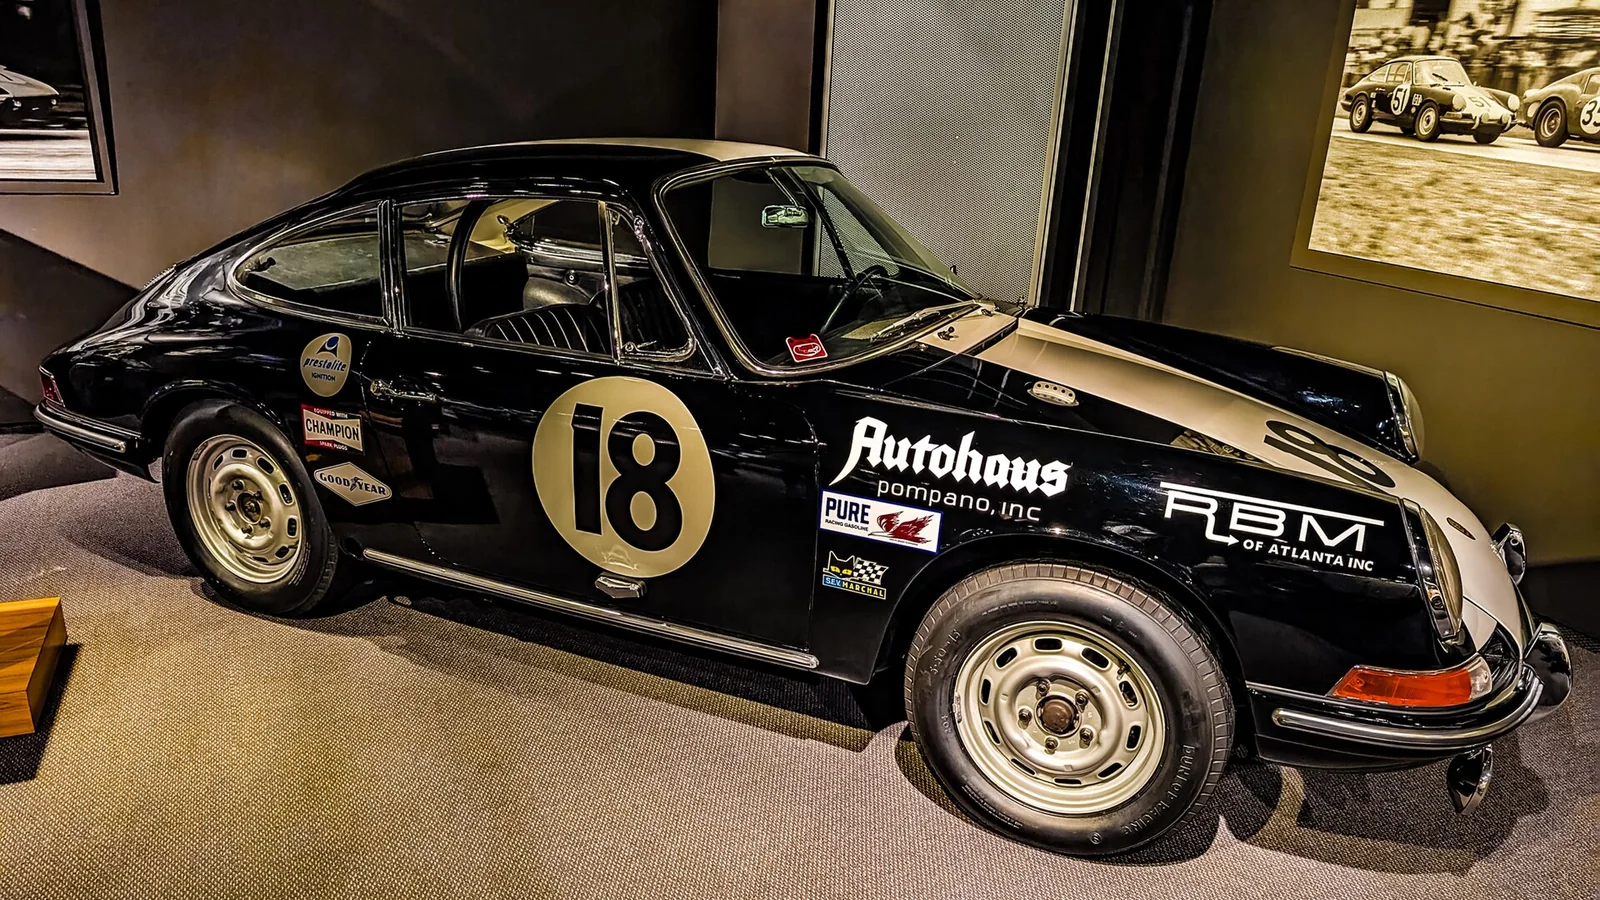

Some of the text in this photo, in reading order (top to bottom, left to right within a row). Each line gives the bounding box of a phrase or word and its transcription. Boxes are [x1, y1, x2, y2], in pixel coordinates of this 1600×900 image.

[1393, 88, 1408, 112] 51
[1468, 96, 1492, 108] 51
[303, 357, 347, 372] prestolite
[311, 372, 336, 381] IGNITION
[313, 407, 348, 419] EQUIPPED WITH
[306, 418, 360, 441] CHAMPION
[319, 440, 348, 451] SPARK PLUGS
[828, 416, 1074, 497] Autohaus
[1263, 419, 1398, 497] 18
[571, 402, 683, 552] 18
[825, 497, 871, 525] PURE
[1164, 490, 1366, 552] RBM
[825, 519, 869, 532] RACING GASOLINE
[1243, 538, 1374, 572] OF ATLANTA INC
[842, 580, 884, 597] MARCHAL
